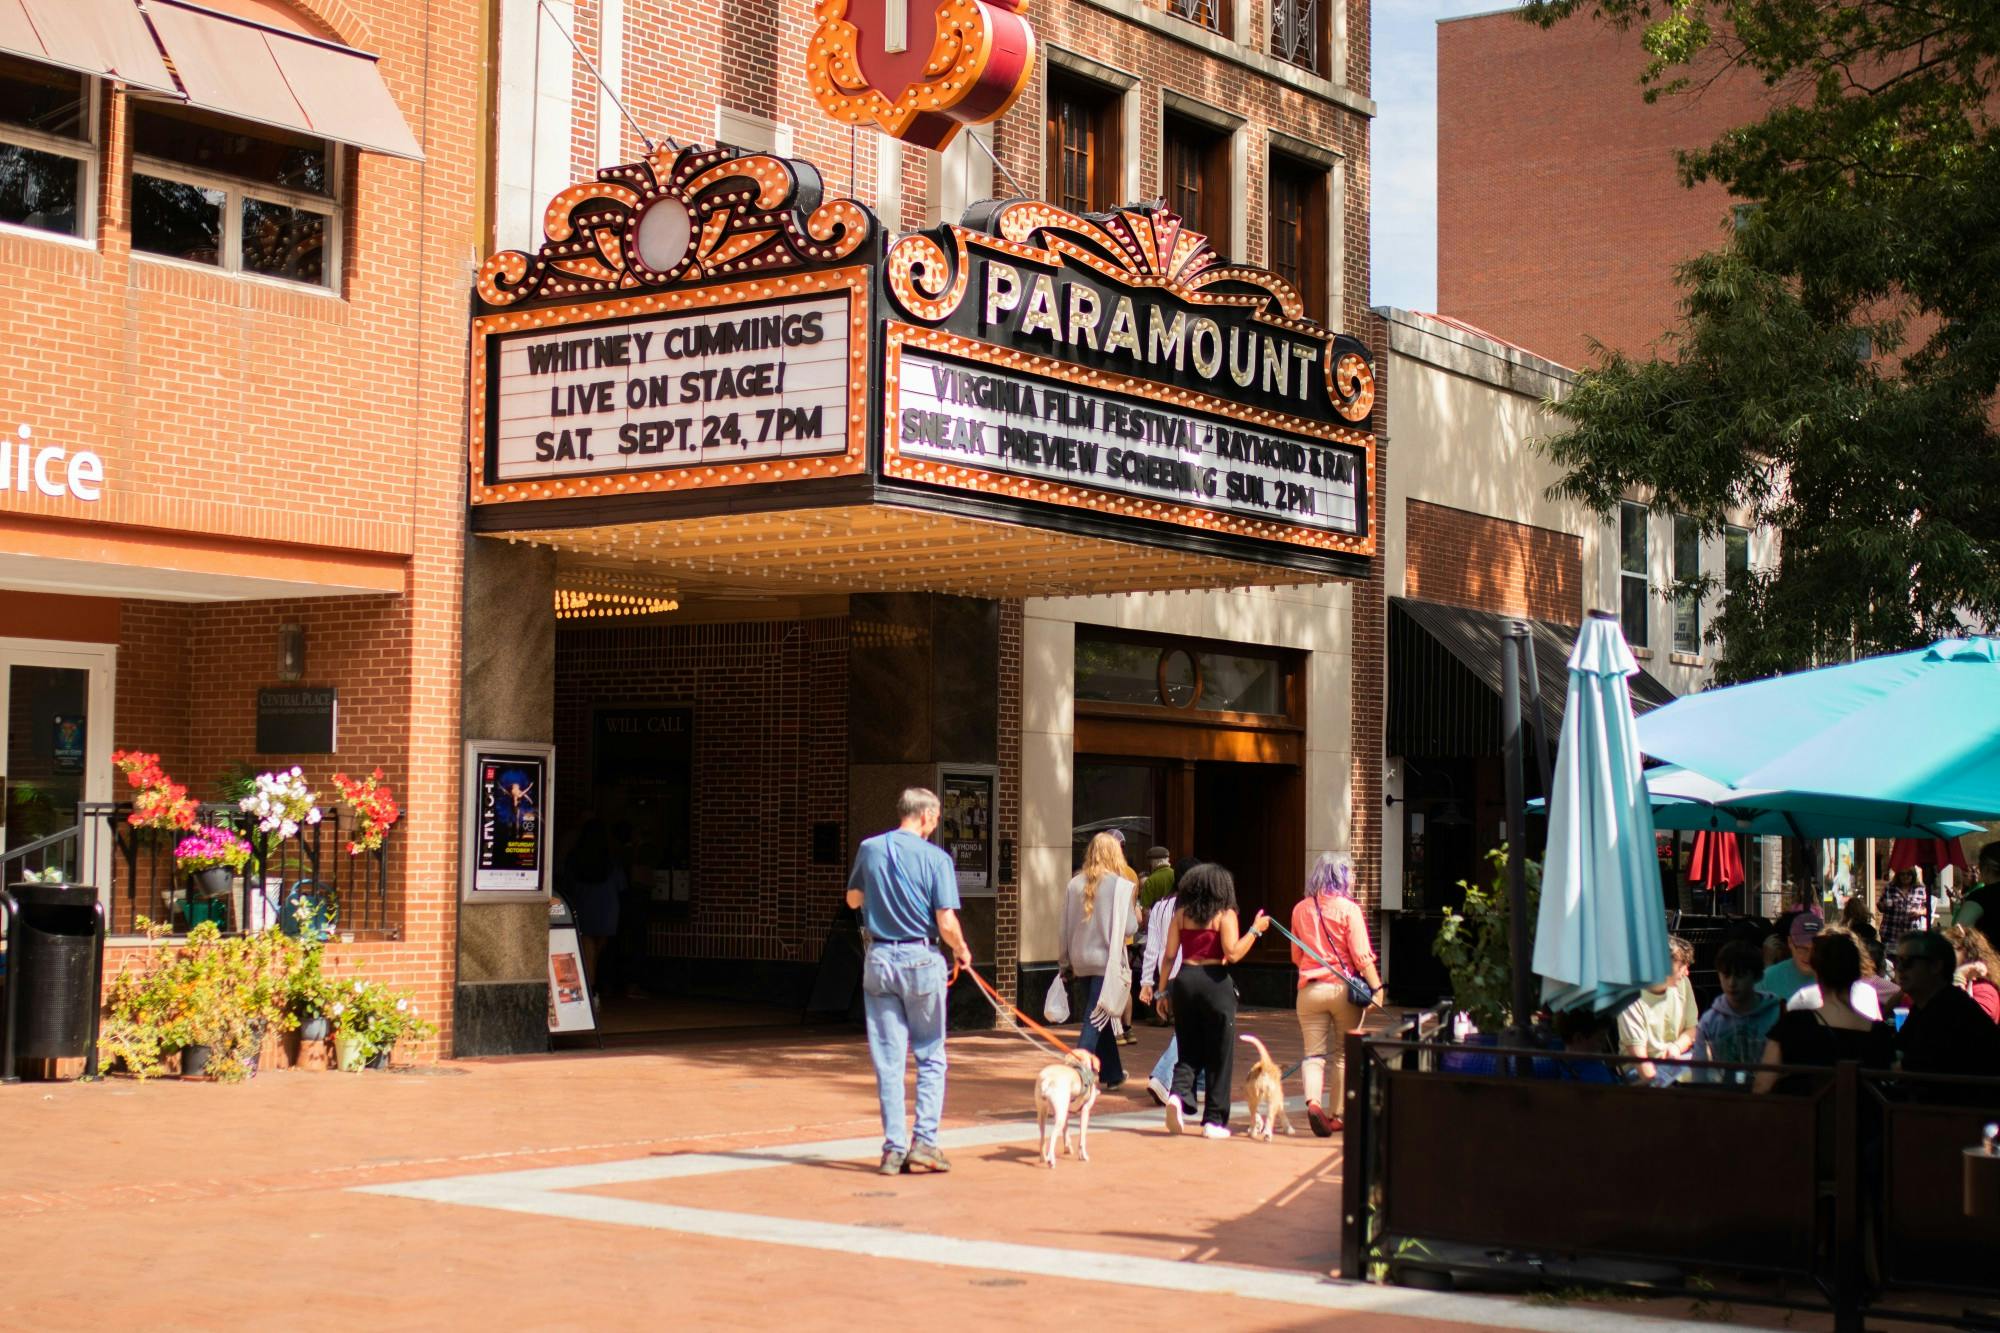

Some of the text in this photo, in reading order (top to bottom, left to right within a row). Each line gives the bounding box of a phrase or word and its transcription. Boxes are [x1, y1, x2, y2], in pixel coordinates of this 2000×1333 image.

[527, 311, 824, 375] WHITNEY CUMMINGS
[983, 260, 1317, 400] PARAMOUNT
[551, 361, 786, 417] LIVE ON STAGE!
[535, 428, 594, 462] SAT.
[618, 417, 696, 454] SEPT.
[755, 405, 823, 443] 7PM
[931, 365, 1038, 418] VIRGINIA
[1043, 389, 1095, 430] FILM
[1102, 401, 1202, 454] FESTIVAL
[1216, 427, 1305, 474] RAYMOND
[901, 407, 1316, 517] SNEAK PREVIEW SCREENING SUN. 2PM
[606, 715, 685, 734] WILL CALL
[950, 843, 978, 851] RAYMOND
[960, 850, 972, 859] RAY
